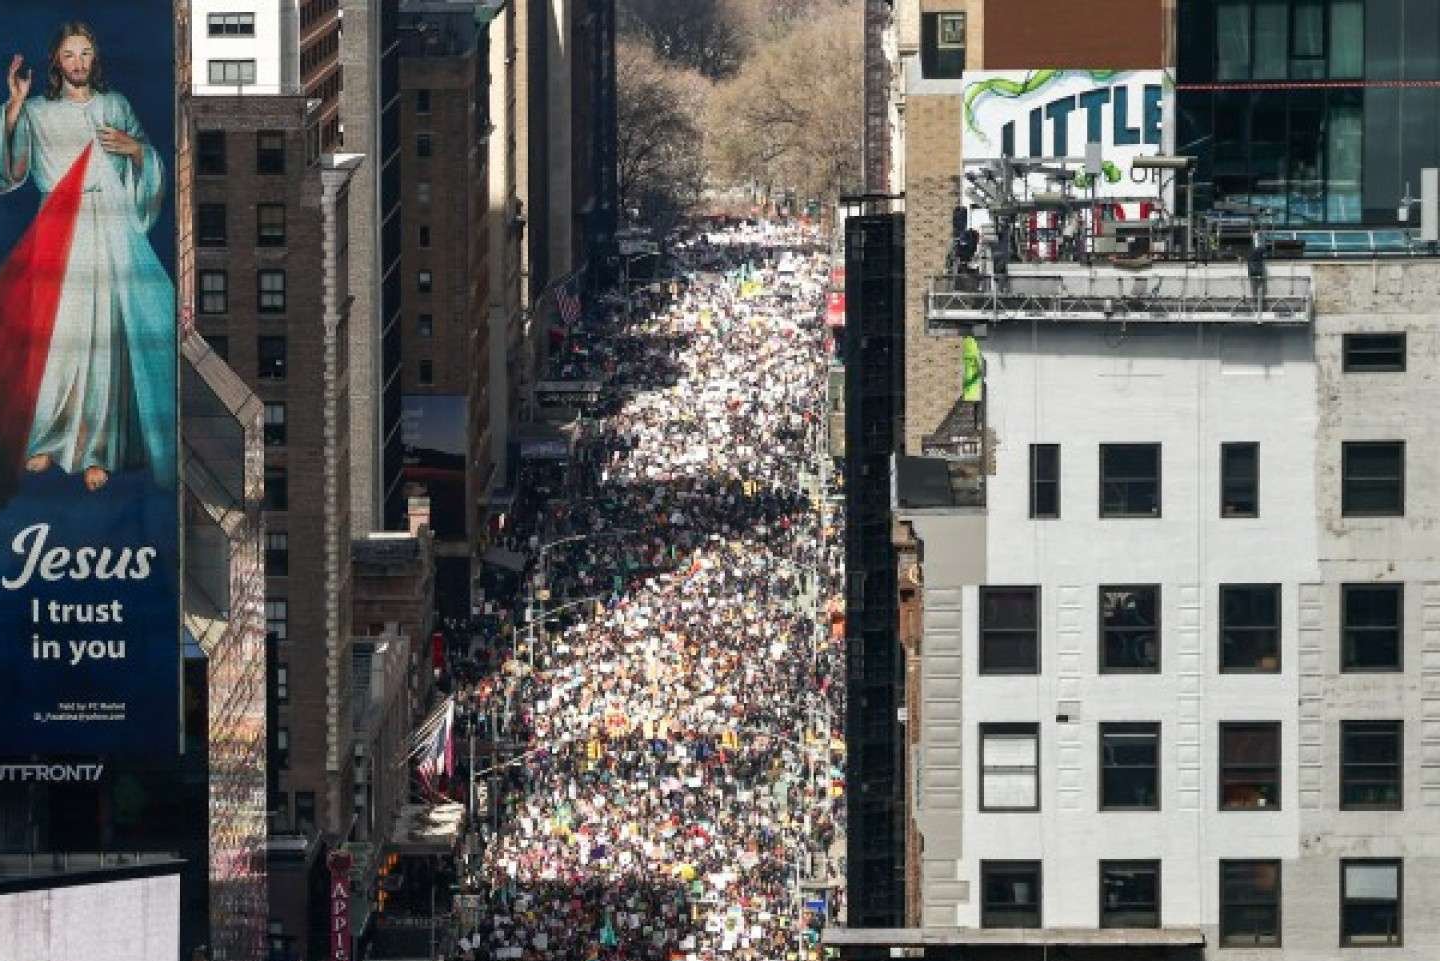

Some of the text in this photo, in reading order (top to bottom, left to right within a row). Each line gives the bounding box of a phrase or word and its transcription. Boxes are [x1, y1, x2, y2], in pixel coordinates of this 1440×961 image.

[2, 523, 157, 590] Jesus
[32, 598, 123, 623] I trust
[33, 633, 126, 666] in you
